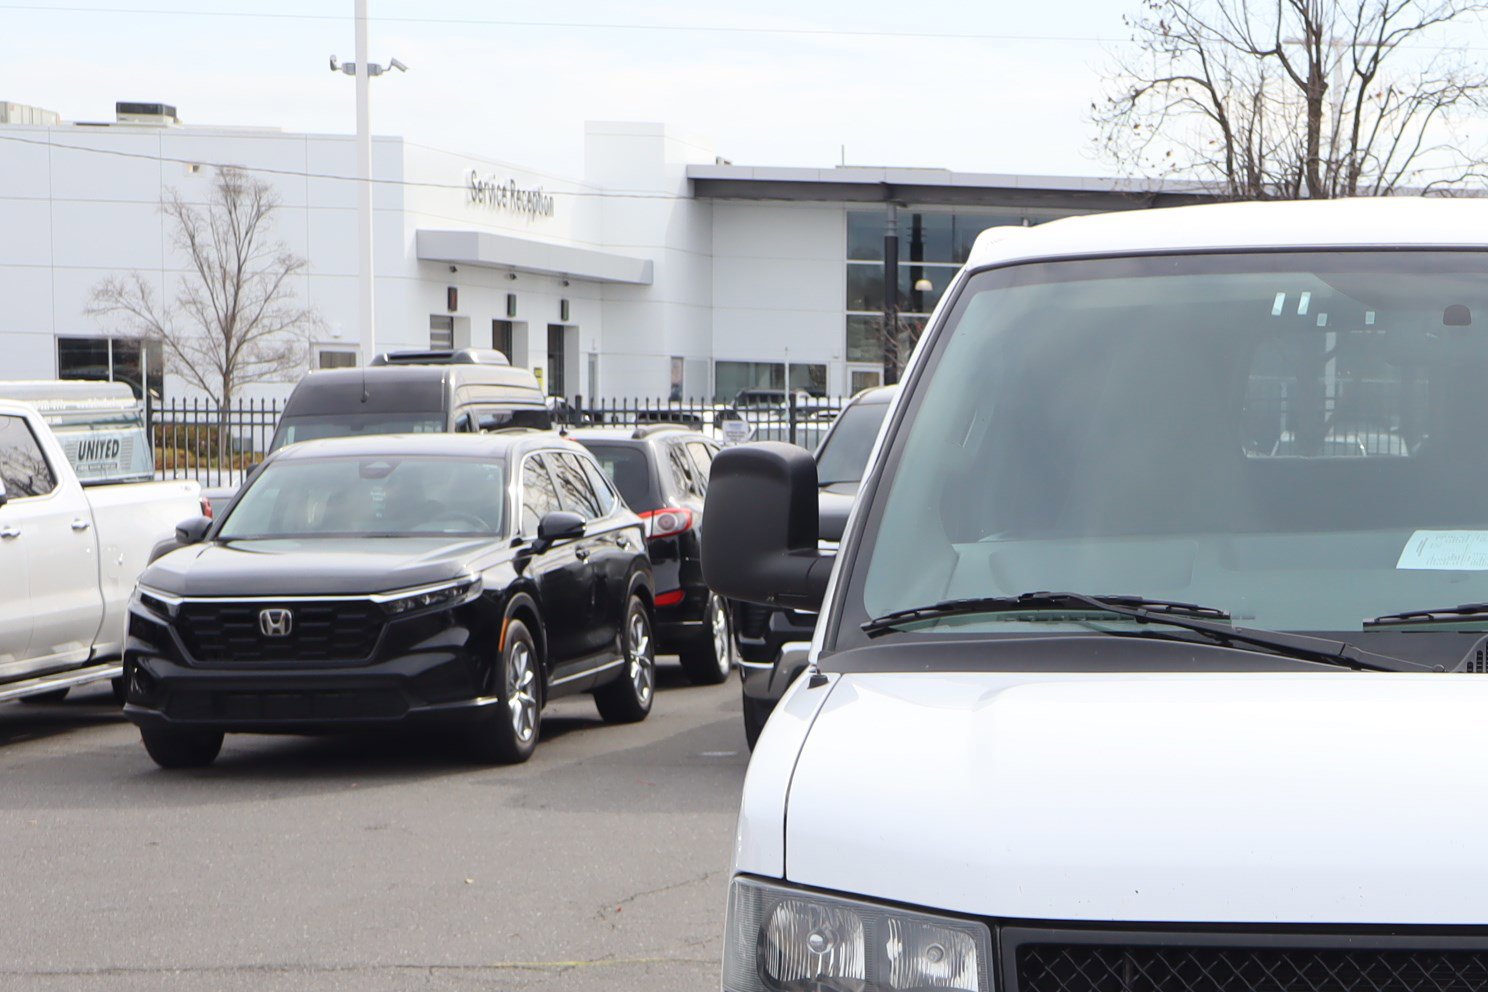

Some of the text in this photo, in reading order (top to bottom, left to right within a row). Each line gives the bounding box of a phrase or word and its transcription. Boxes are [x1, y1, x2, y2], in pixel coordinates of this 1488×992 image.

[470, 169, 554, 222] Service Reception
[78, 439, 120, 461] UNITED
